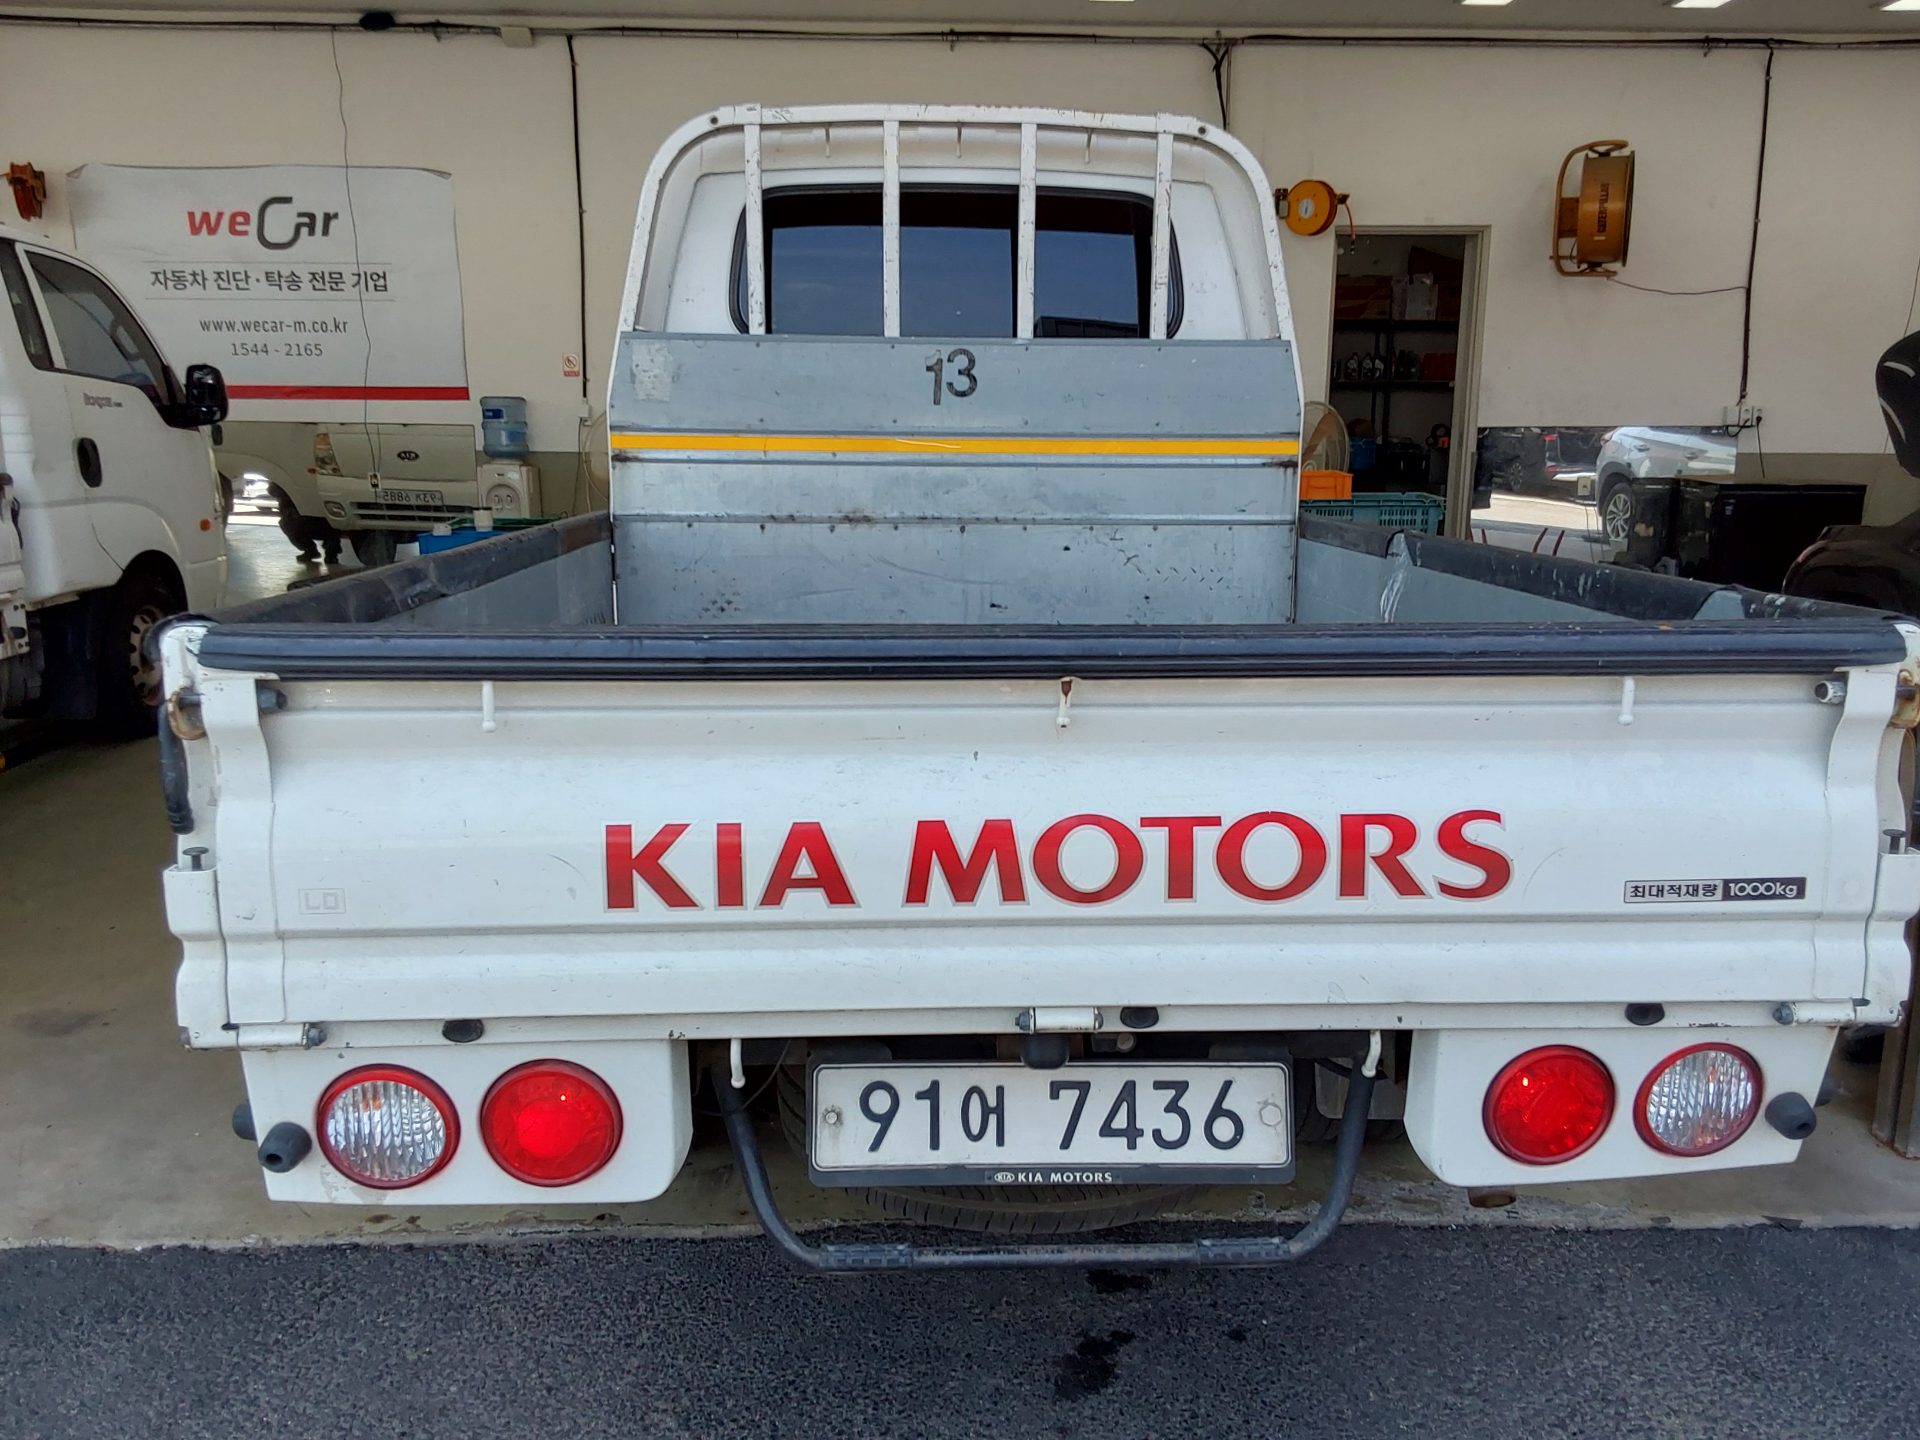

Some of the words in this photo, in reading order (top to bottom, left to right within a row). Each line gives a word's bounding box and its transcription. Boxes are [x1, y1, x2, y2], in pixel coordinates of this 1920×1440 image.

[187, 196, 339, 250] weCar
[150, 270, 207, 291] 자동차
[308, 271, 346, 292] 전문
[351, 271, 389, 292] 기업
[199, 317, 349, 334] www.wecar-m.co.kr
[231, 343, 270, 357] 1544
[285, 343, 324, 357] 2165
[924, 347, 978, 406] 13
[604, 819, 861, 910] KIA
[901, 808, 1515, 907] MOTORS
[1629, 883, 1719, 898] 최대적재량
[1728, 882, 1798, 898] 1000kg
[859, 1080, 1005, 1152] 91어
[1049, 1079, 1245, 1151] 7436
[1018, 1172, 1043, 1183] KIA
[1050, 1172, 1113, 1183] MOTORS
